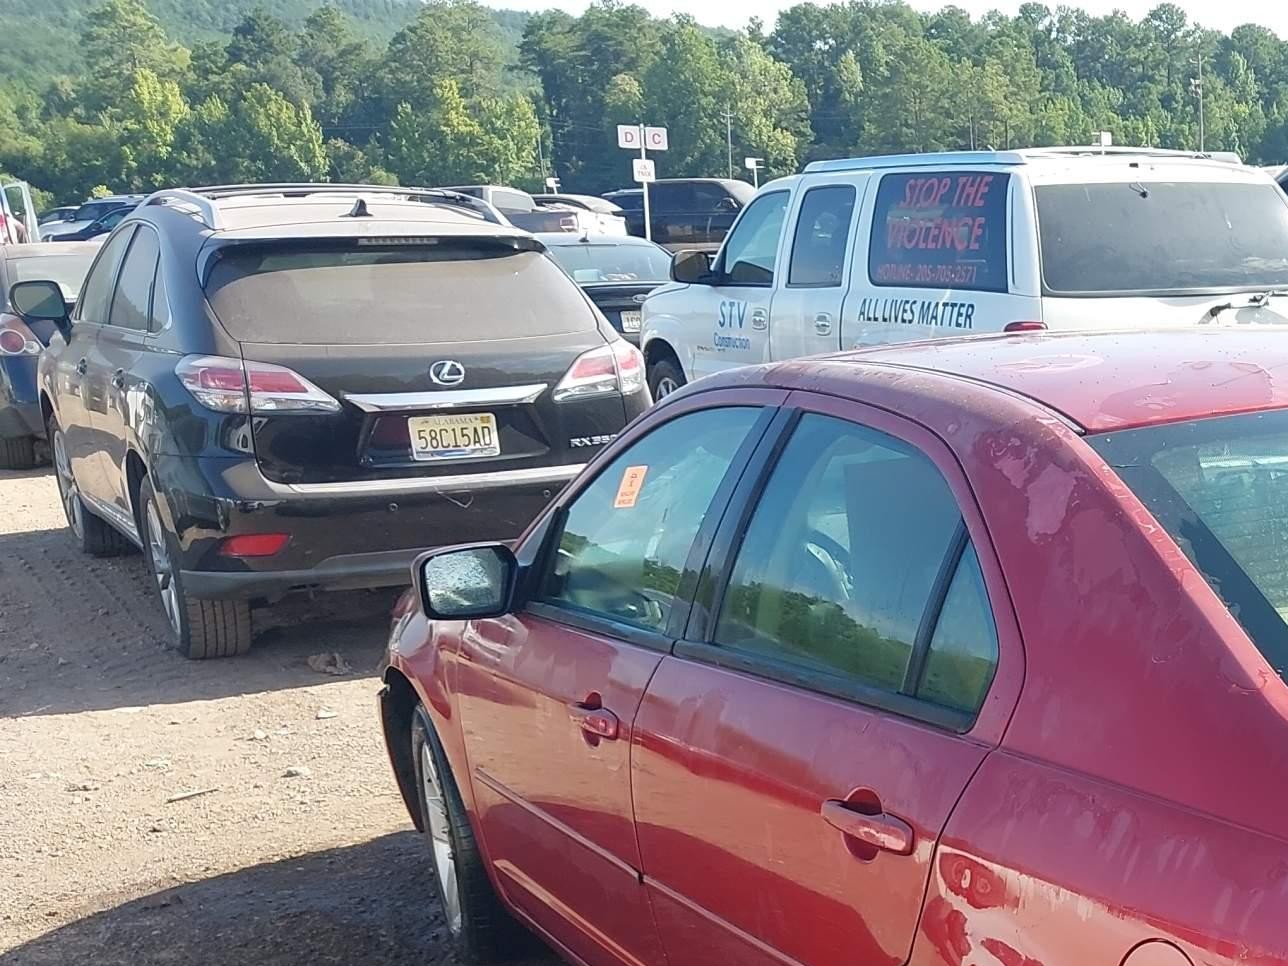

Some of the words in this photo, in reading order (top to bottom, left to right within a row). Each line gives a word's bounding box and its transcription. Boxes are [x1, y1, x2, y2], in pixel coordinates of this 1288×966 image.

[624, 131, 634, 143] D
[651, 132, 661, 145] C
[900, 177, 951, 208] STOP
[952, 175, 994, 207] THE
[886, 216, 985, 251] VIOLENCE
[718, 300, 748, 329] STV
[858, 298, 879, 322] ALL
[881, 299, 918, 325] LIVES
[918, 301, 975, 329] MATTER
[417, 425, 492, 450] 58C15AD
